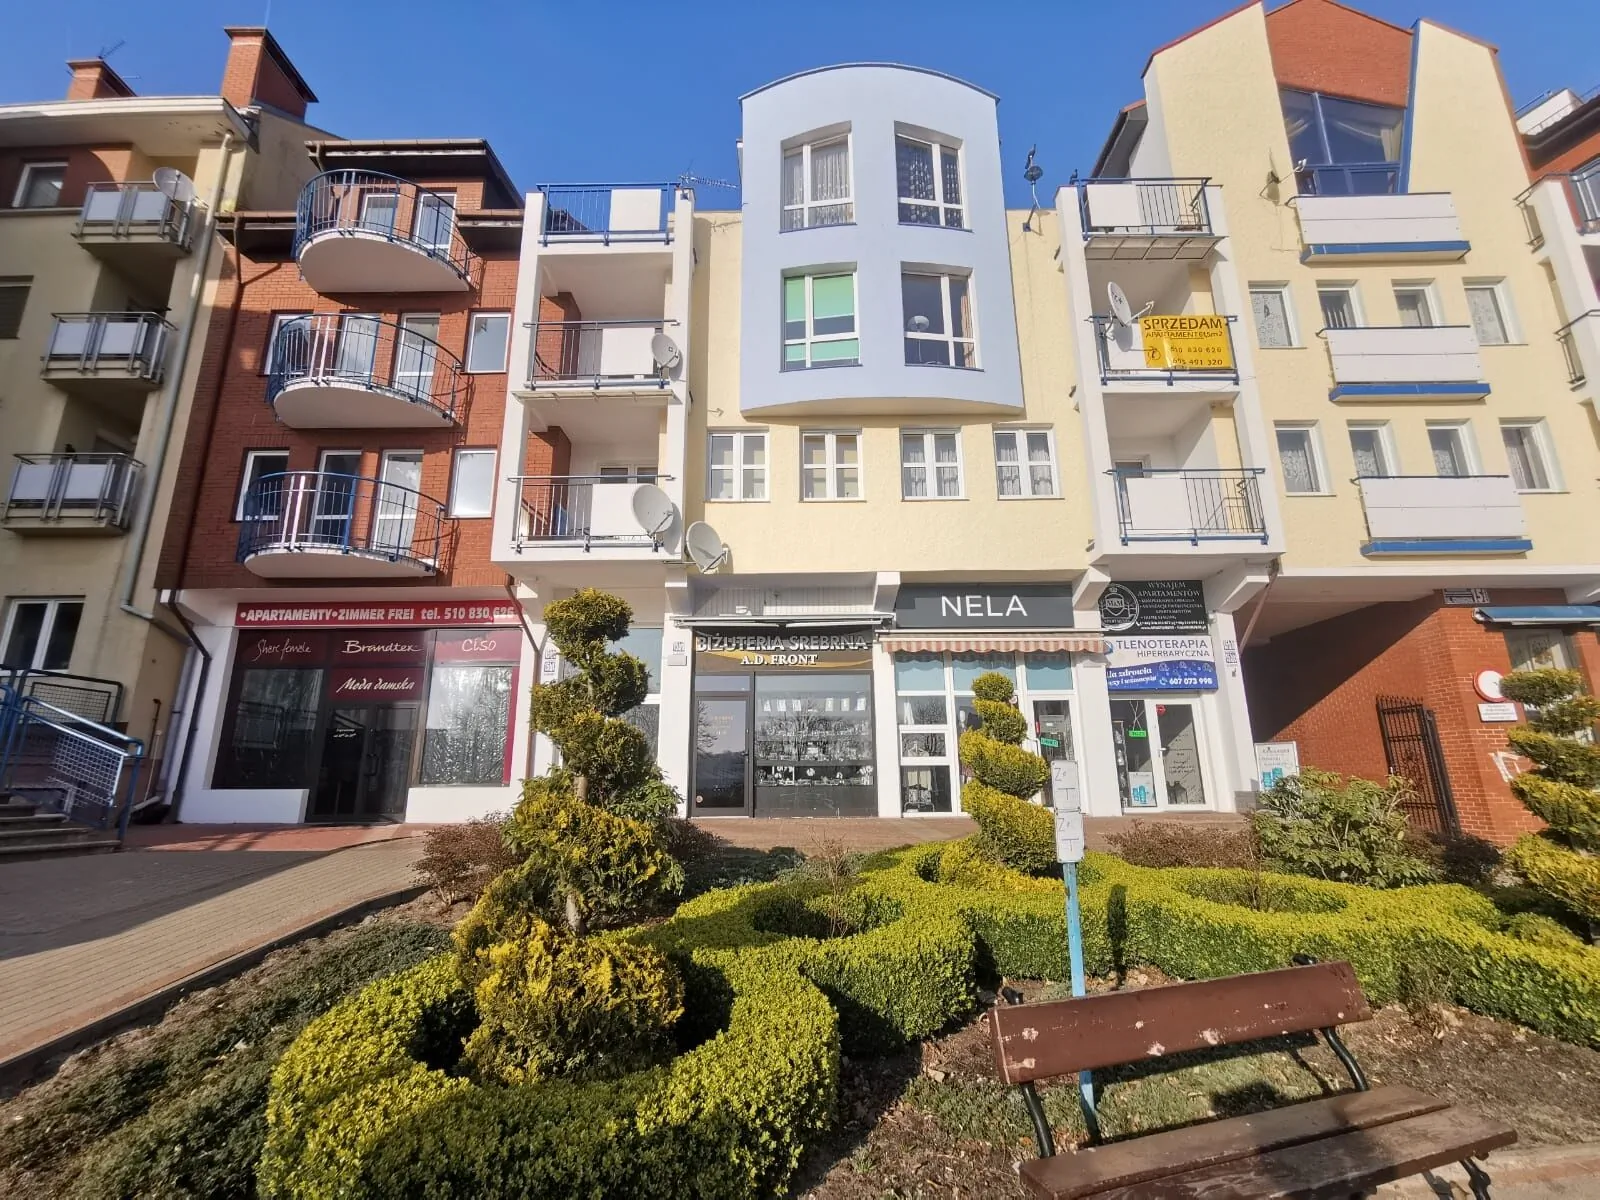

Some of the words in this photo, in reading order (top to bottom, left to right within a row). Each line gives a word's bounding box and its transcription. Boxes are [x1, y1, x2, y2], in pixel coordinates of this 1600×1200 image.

[1144, 318, 1222, 330] SPRZEDAM
[1148, 582, 1186, 590] WYNAJEM
[1137, 589, 1200, 597] APARTAMENTÓW
[941, 595, 1028, 617] NELA
[246, 608, 332, 621] APARTAMENTY
[337, 608, 384, 620] ZIMMER
[388, 608, 414, 620] FREI
[421, 607, 440, 620] tel.
[444, 608, 465, 620] 510
[469, 607, 490, 619] 830
[341, 640, 424, 653] Brandtex
[697, 633, 785, 651] BIŻUTERIA
[788, 634, 868, 650] SREBRNA
[1116, 640, 1208, 649] TLENOTERAPIA
[740, 654, 768, 666] A.D.
[772, 654, 818, 666] FRONT
[1137, 650, 1210, 658] HIPERBARYCZNA
[336, 678, 373, 693] Moda
[373, 677, 415, 690] damska
